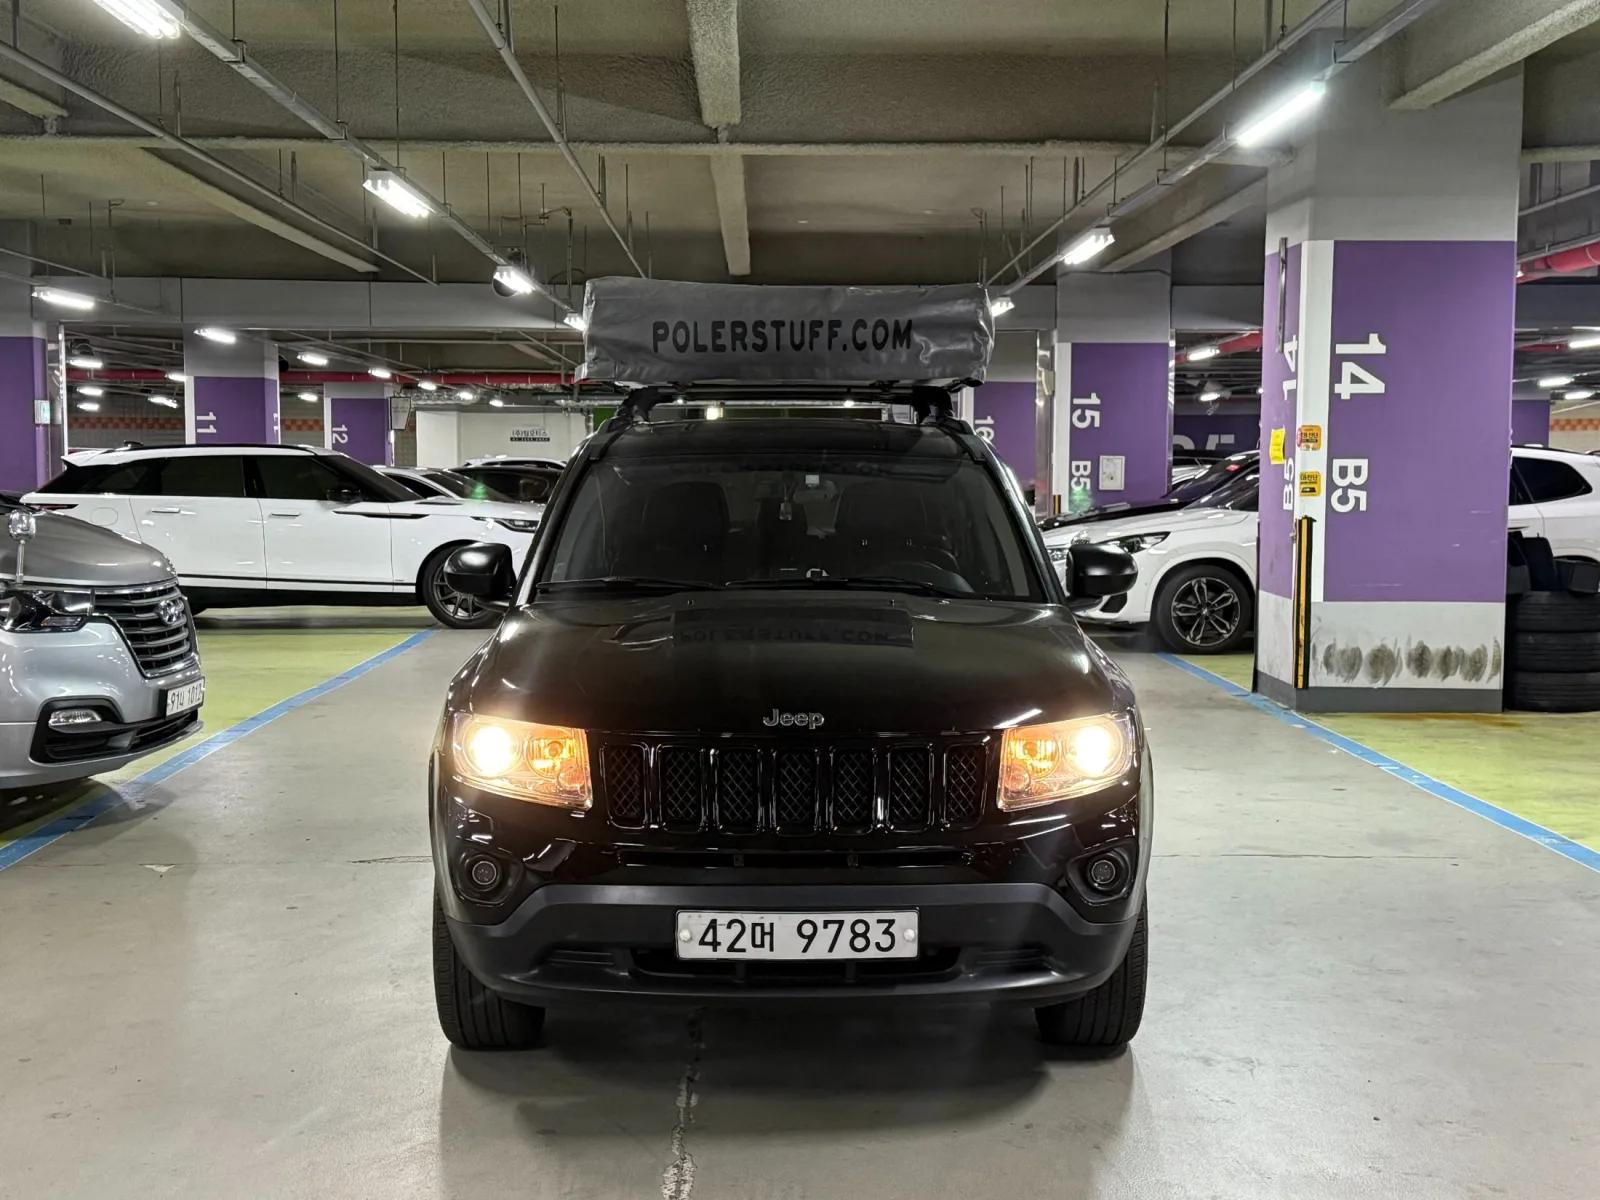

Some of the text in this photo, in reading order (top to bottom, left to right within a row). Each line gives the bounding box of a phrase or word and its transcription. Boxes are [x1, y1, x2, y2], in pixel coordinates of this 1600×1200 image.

[652, 319, 913, 354] POLERSTUFF.COM
[1282, 334, 1298, 401] 14
[1334, 333, 1387, 400] 14
[196, 411, 217, 434] 11
[1071, 392, 1101, 429] 15
[331, 424, 349, 444] 12
[1070, 460, 1092, 491] B5
[1330, 458, 1369, 513] B5
[762, 708, 825, 730] Jeep
[698, 918, 896, 954] 42머 9783
